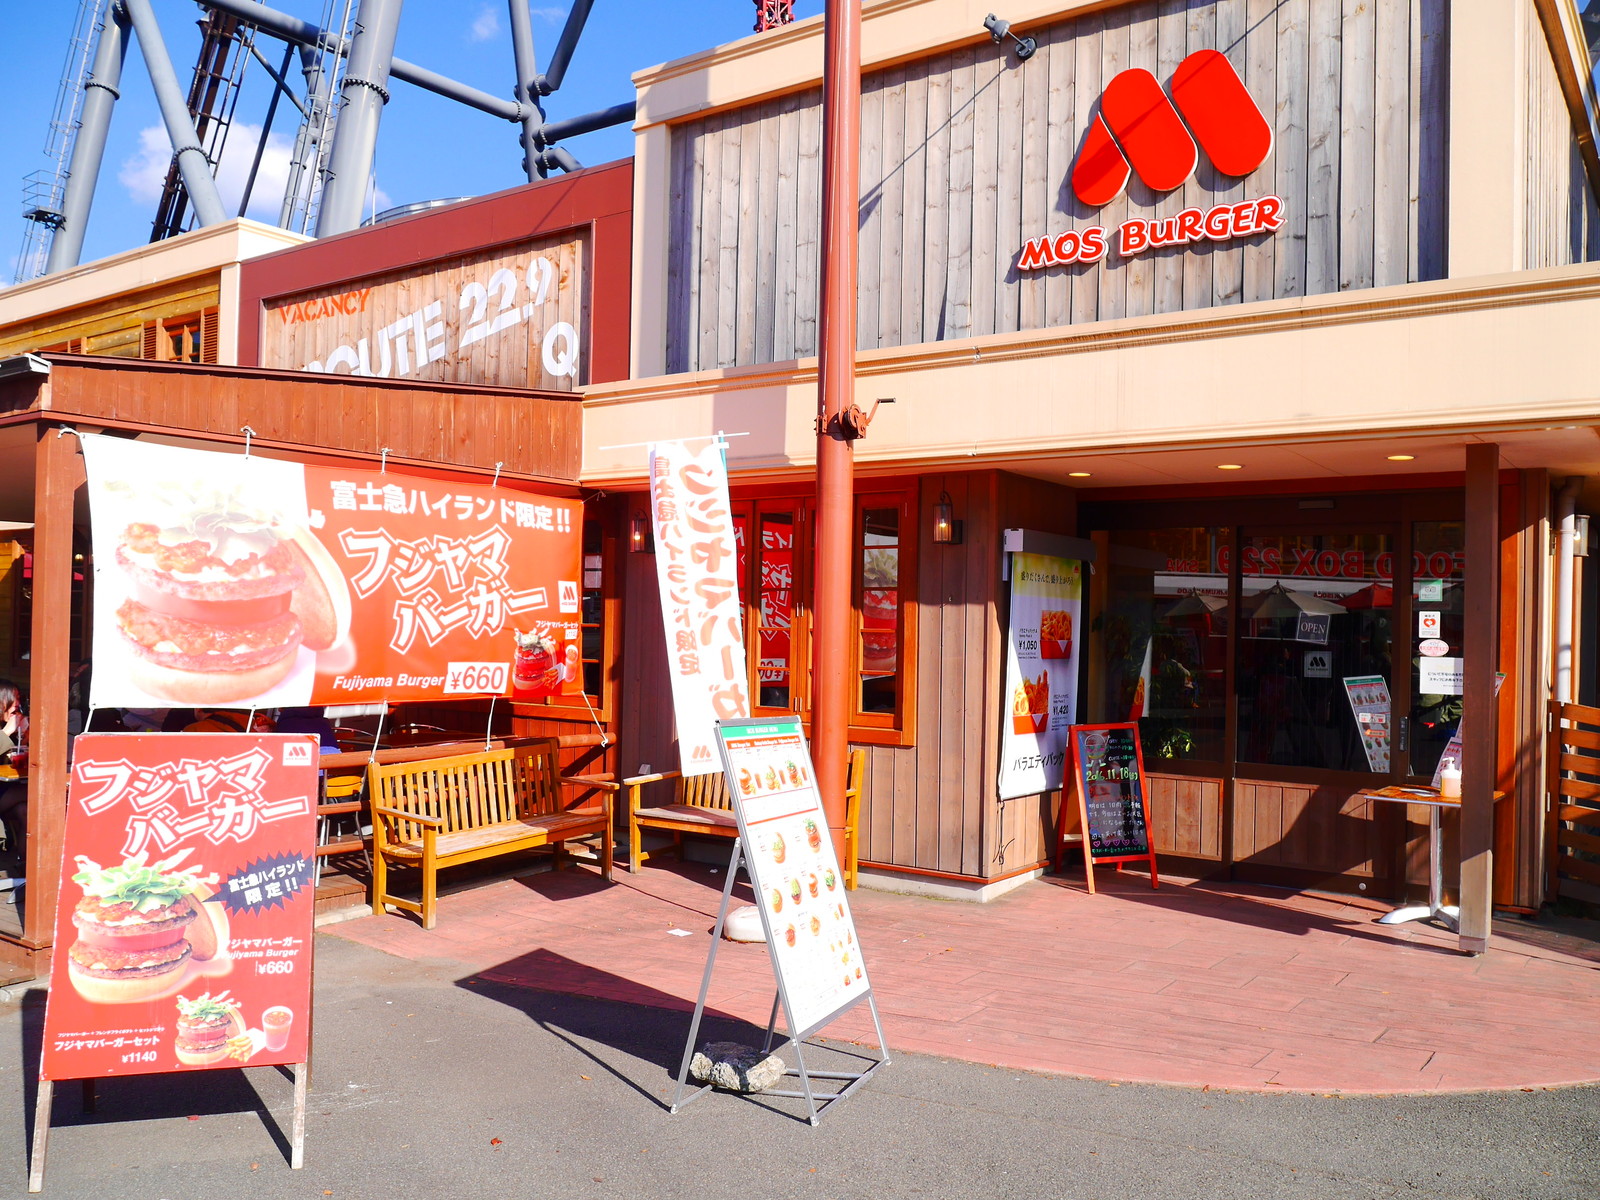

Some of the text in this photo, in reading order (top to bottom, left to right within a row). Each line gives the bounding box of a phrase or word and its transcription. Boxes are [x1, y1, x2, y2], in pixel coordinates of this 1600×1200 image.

[1017, 195, 1288, 270] MOS BURGER
[278, 287, 371, 325] VACANCY
[542, 321, 579, 378] Q
[338, 524, 512, 599] フジヤマ
[390, 577, 549, 655] バーガー
[1300, 622, 1326, 634] OPEN
[1018, 640, 1038, 651] ¥1,050
[332, 673, 445, 691] Fujiyama Burger
[450, 665, 503, 690] ¥660
[76, 747, 273, 816] フジヤマ
[121, 793, 310, 857] バーガー
[228, 859, 305, 893] 富士急ハイランド
[258, 961, 293, 974] ¥660
[266, 949, 298, 958] Burger
[54, 1035, 160, 1051] フジヤマバーガーセット
[121, 1051, 157, 1063] ¥1140
